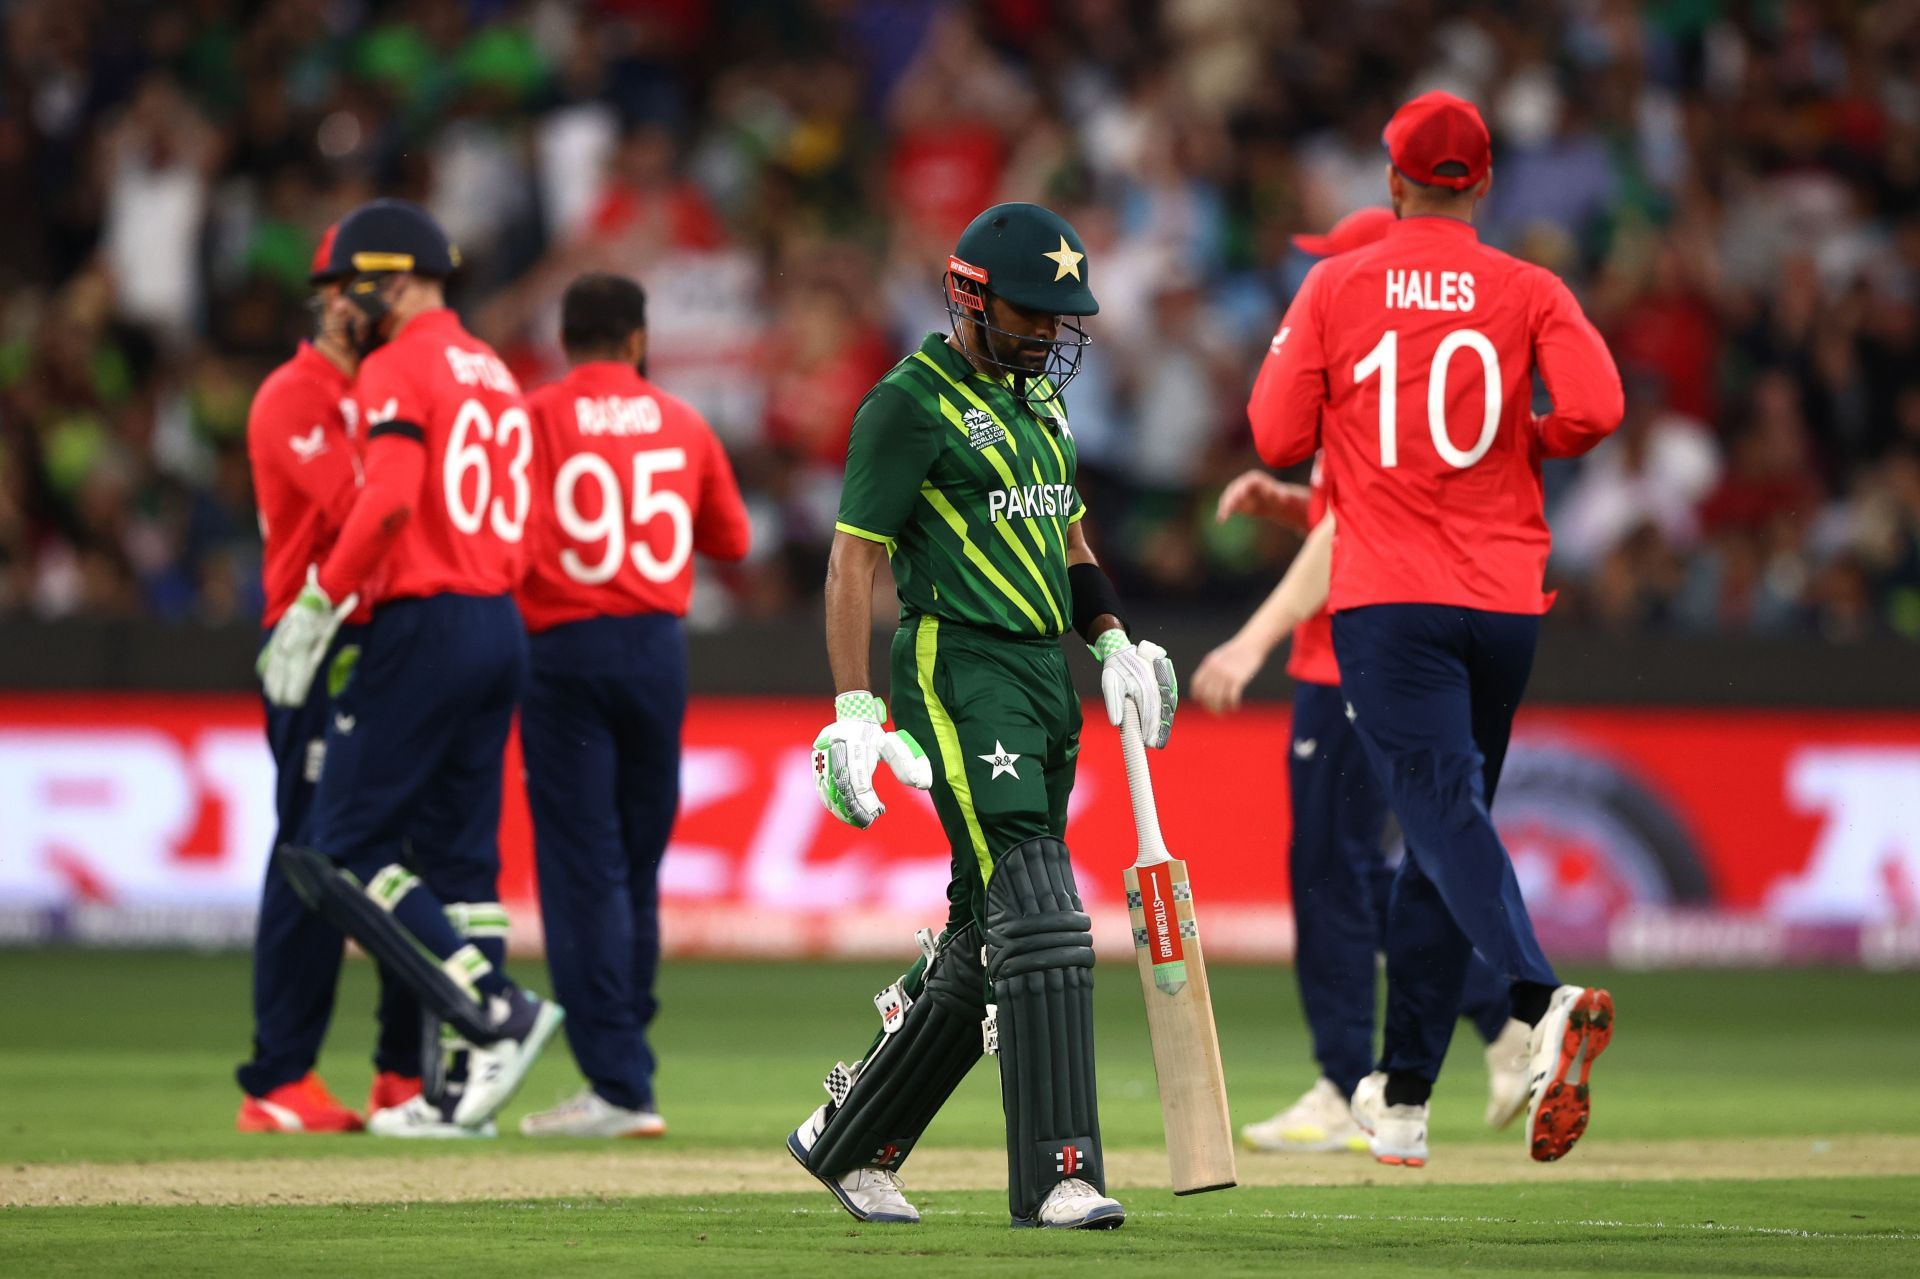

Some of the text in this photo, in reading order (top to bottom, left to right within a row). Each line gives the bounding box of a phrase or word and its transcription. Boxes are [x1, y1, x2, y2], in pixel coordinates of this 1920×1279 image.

[1386, 269, 1475, 312] HALES
[574, 394, 663, 437] RASHID
[1353, 328, 1502, 469] 10
[969, 430, 1005, 448] WORLD CUP
[970, 430, 990, 441] MEN'S
[443, 398, 533, 543] 63
[553, 447, 693, 585] 95
[1153, 900, 1173, 958] GRAY-NICOLLS
